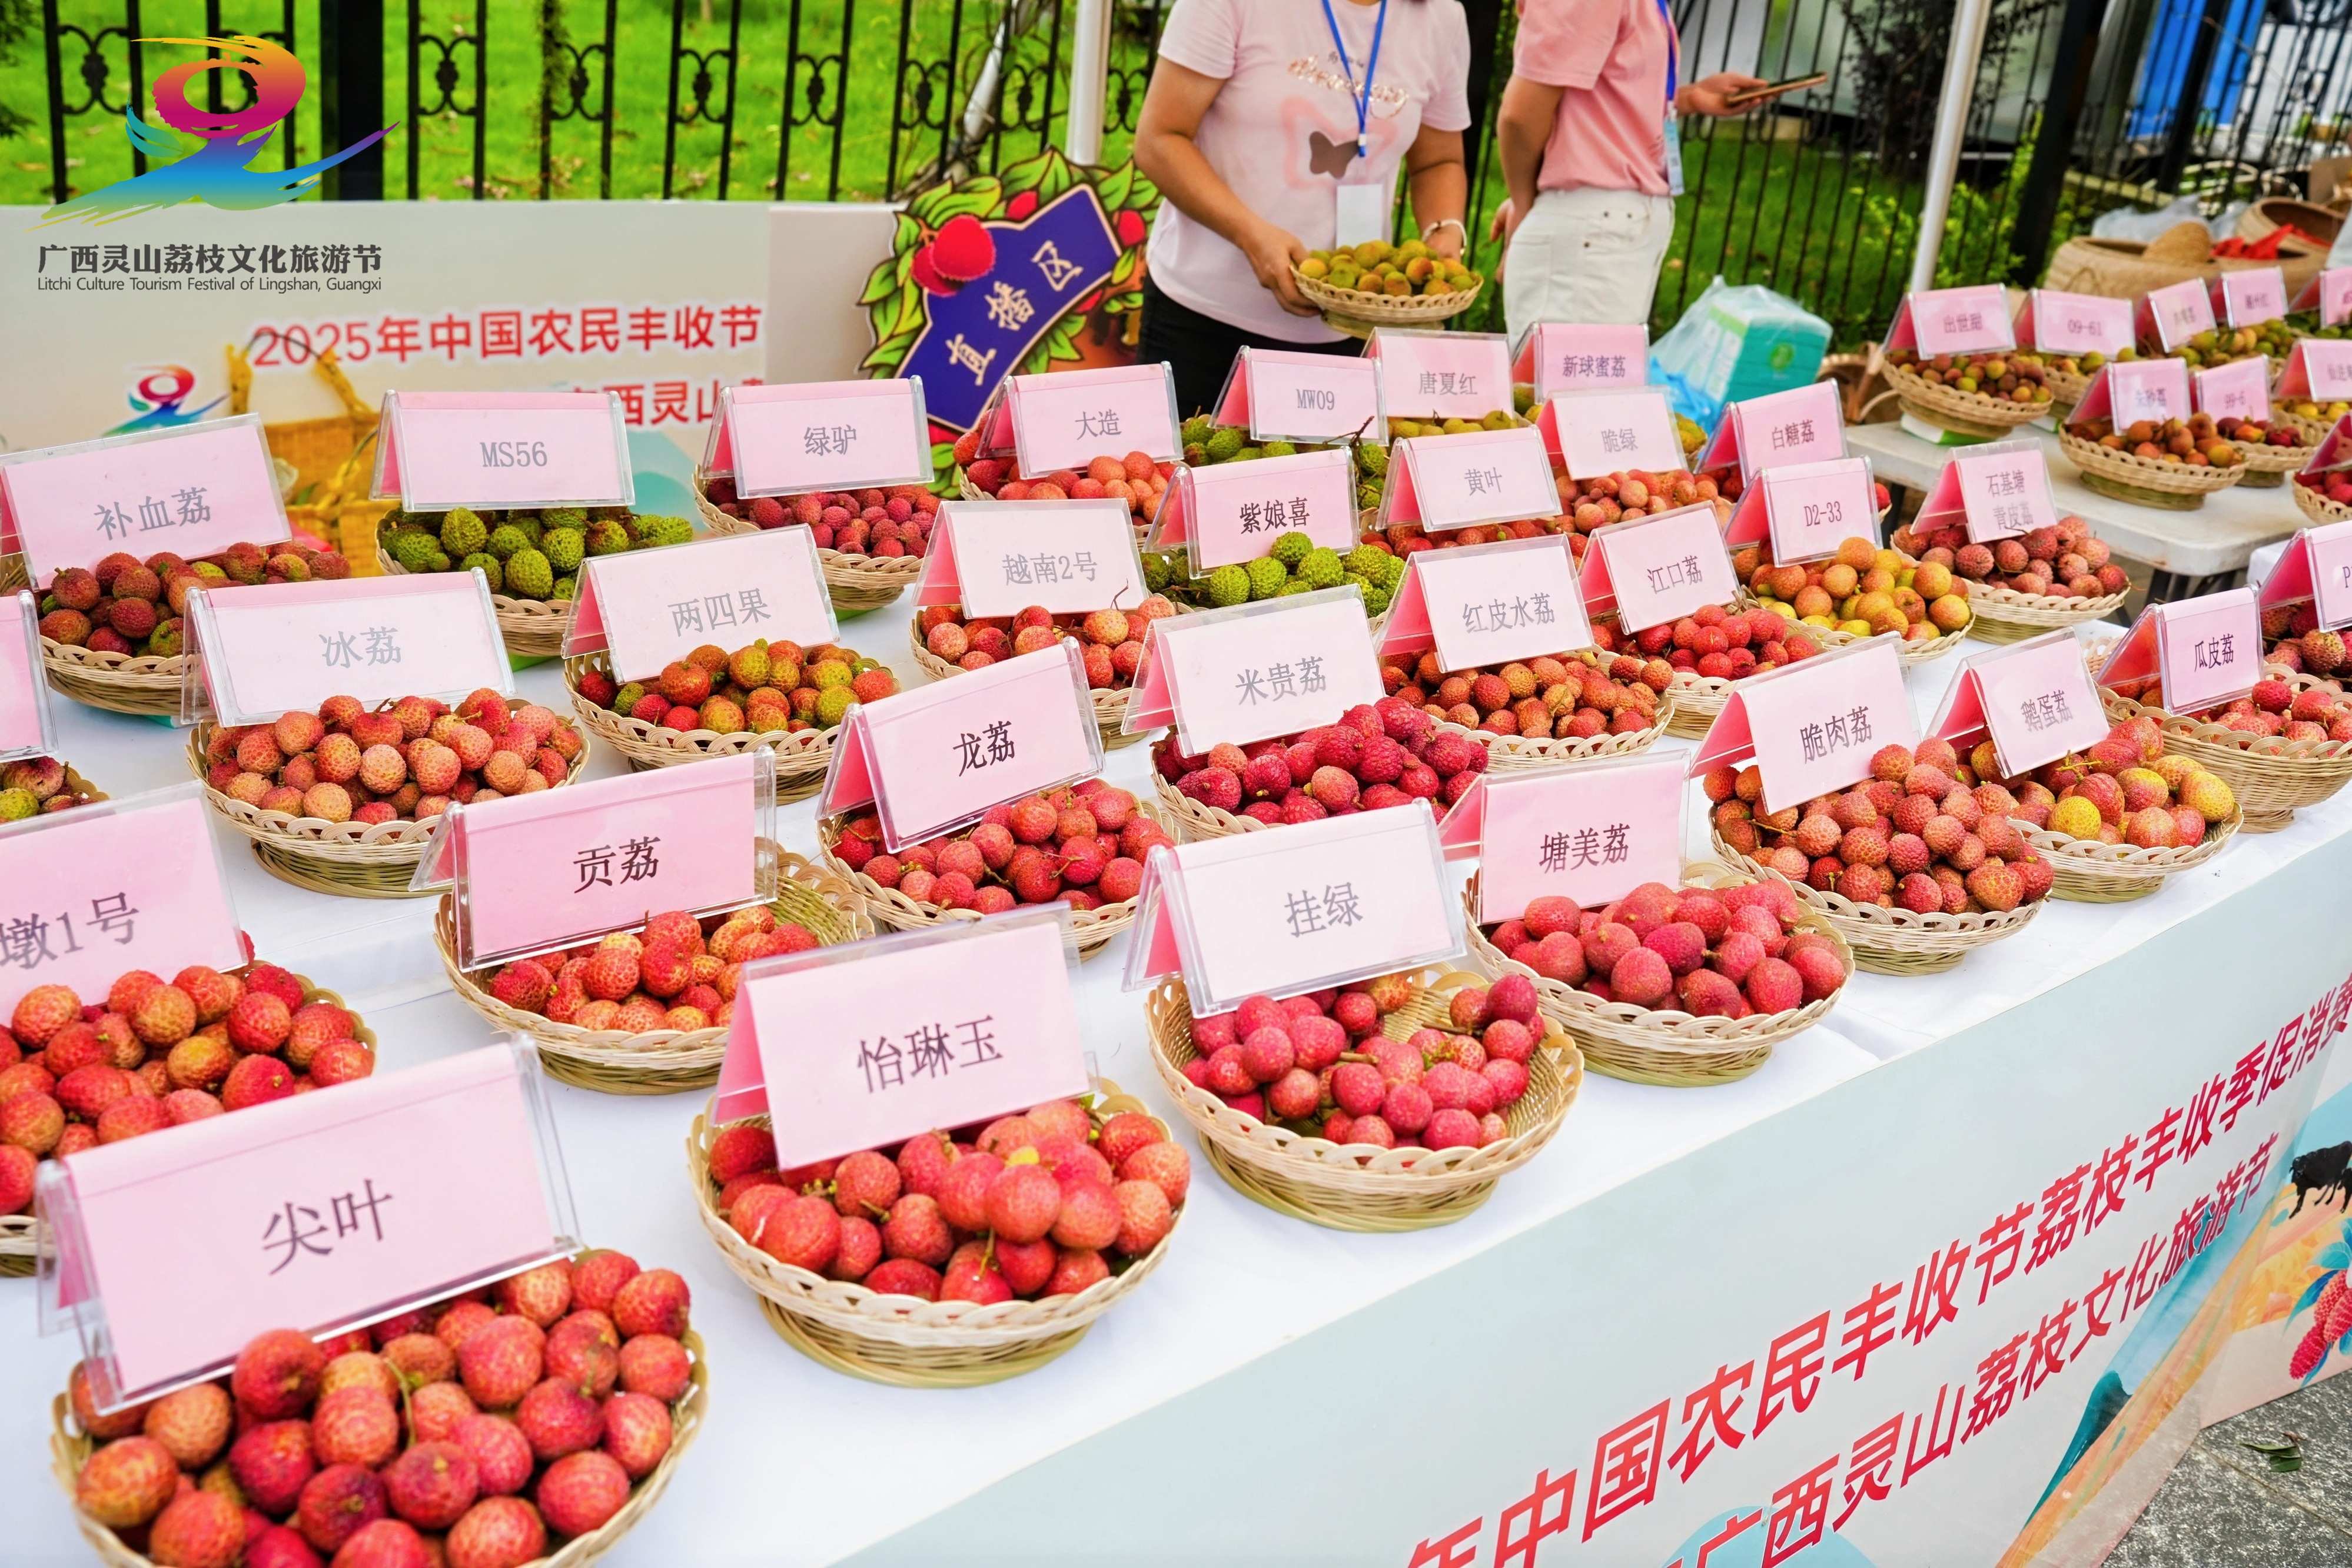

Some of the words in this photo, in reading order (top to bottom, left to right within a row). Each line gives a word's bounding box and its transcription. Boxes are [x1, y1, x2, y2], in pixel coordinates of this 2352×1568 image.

[945, 240, 1083, 386] 直播区
[254, 304, 761, 367] 2025年中国农民丰收节
[1419, 371, 1477, 396] 唐夏红
[1563, 355, 1626, 377] 新球蜜荔
[573, 378, 763, 425] 西灵山
[1297, 389, 1334, 410] MW09
[804, 424, 856, 456] 绿驴
[1075, 409, 1122, 440] 大造
[1601, 428, 1638, 453] 脆绿
[1772, 419, 1814, 450] 白糖荔
[480, 441, 547, 467] MS56
[1464, 467, 1502, 496] 黄叶
[1986, 470, 2024, 497] 石基塘
[94, 487, 210, 540] 补血荔
[1240, 497, 1310, 534] 紫娘喜
[1803, 501, 1842, 526] D2-33
[1002, 552, 1097, 586] 越南2号
[1647, 555, 1703, 594] 江口荔
[667, 588, 771, 637] 两四果
[1463, 592, 1554, 633] 红皮水荔
[318, 626, 401, 669] 冰荔
[2195, 633, 2233, 672] 瓜皮荔
[1235, 656, 1326, 705] 米贵荔
[2021, 690, 2072, 730] 鹅蛋荔
[953, 721, 1015, 776] 龙荔
[1800, 706, 1873, 764] 脆肉荔
[573, 836, 660, 893] 贡荔
[1539, 823, 1630, 873] 塘美荔
[1284, 882, 1363, 938] 挂绿
[858, 1015, 1002, 1092] 怡琳玉
[264, 1180, 392, 1274] 尖叶
